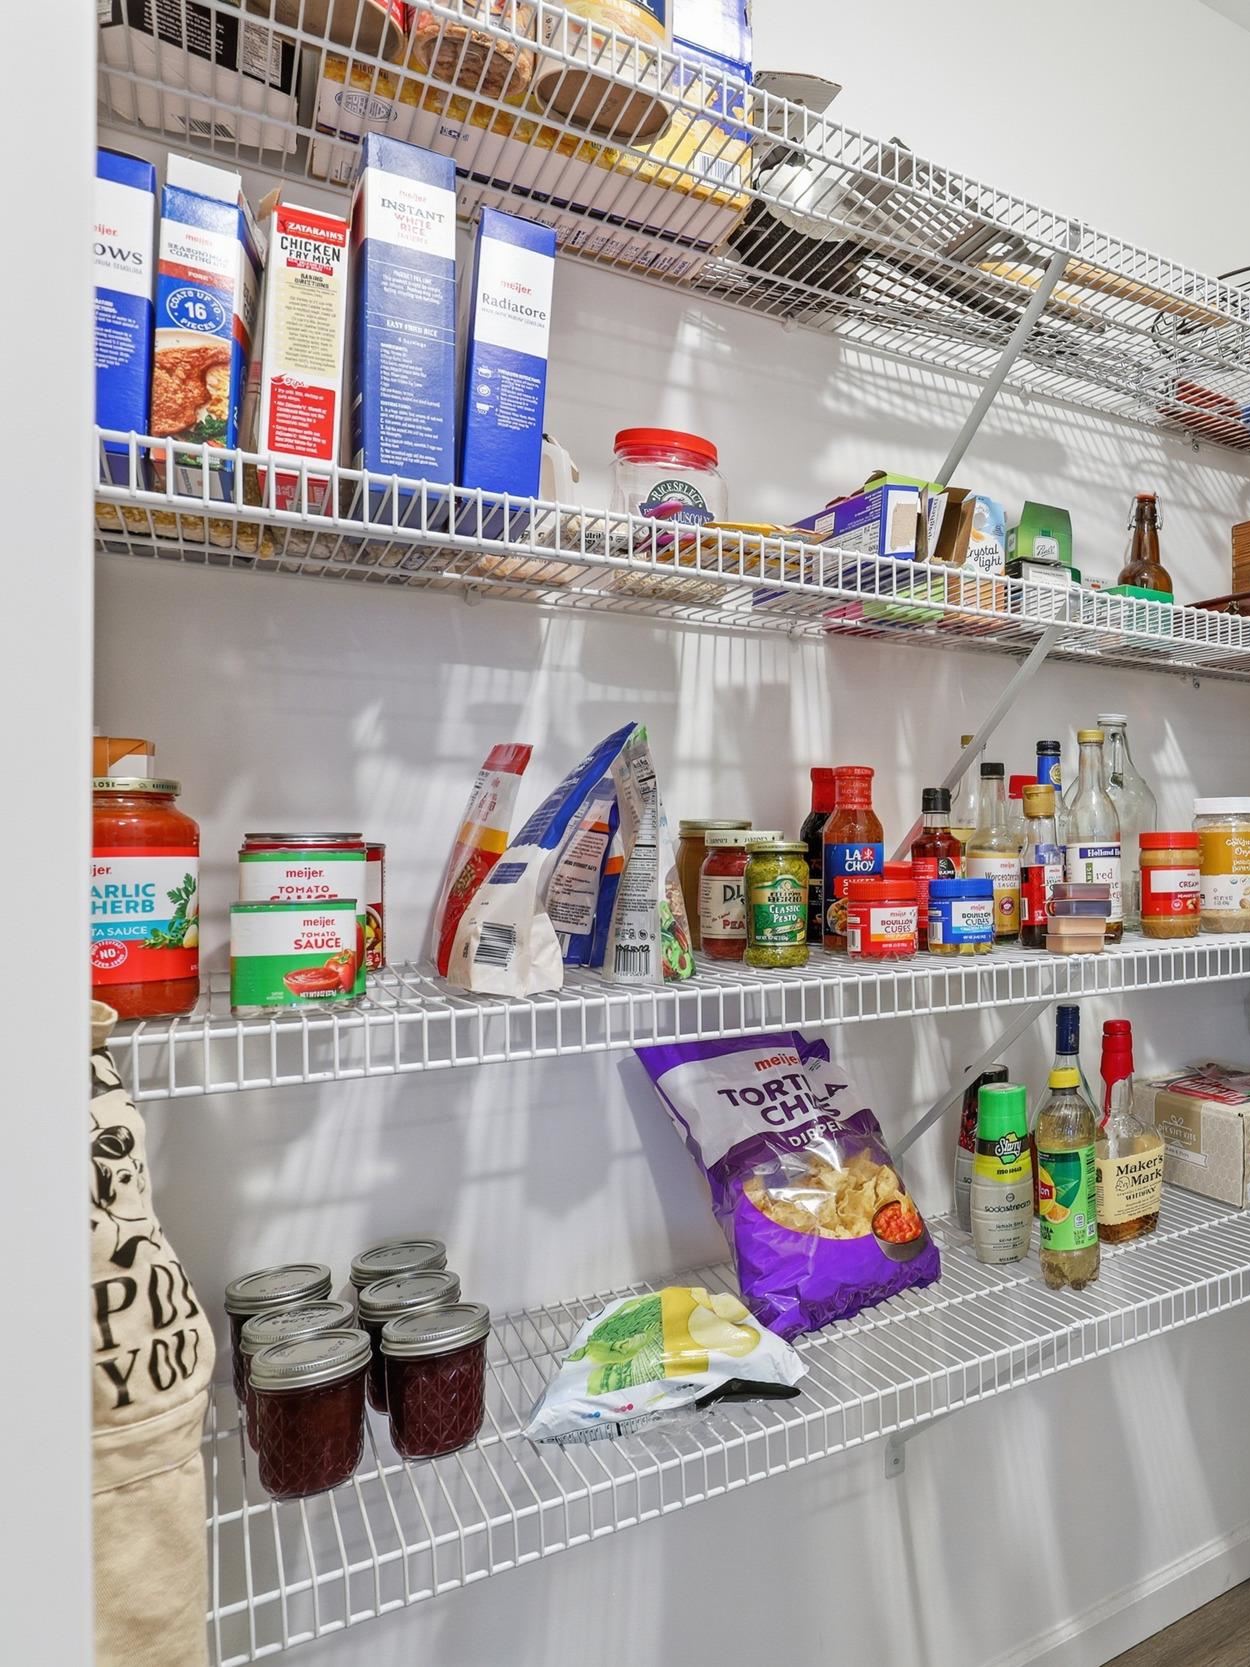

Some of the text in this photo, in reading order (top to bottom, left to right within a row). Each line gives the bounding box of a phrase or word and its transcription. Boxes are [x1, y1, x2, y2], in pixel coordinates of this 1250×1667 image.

[381, 198, 445, 223] INSTANT
[394, 213, 432, 230] WHITE
[94, 224, 118, 237] ijer
[287, 222, 345, 241] ZATARAIN'S
[400, 224, 425, 236] RICE
[281, 236, 341, 262] CHICKEN
[289, 250, 309, 261] FRY
[312, 254, 331, 266] MIX
[501, 279, 532, 296] meijer
[170, 290, 221, 314] COATS UP TO
[482, 292, 546, 320] Radiatore
[184, 302, 207, 320] 16
[180, 317, 216, 331] PIECES
[387, 319, 403, 330] EASY
[424, 326, 438, 337] RICE
[651, 481, 703, 506] RICESELECT
[978, 557, 1003, 572] light
[845, 849, 861, 861] LA
[1087, 849, 1114, 857] Holland
[92, 865, 112, 877] jer
[286, 867, 323, 880] meijer
[845, 860, 875, 872] CHOY
[1096, 868, 1113, 880] red
[91, 883, 156, 899] ARLIC
[278, 885, 329, 894] TOMATO
[1179, 880, 1199, 888] CREAM
[92, 900, 155, 915] HERB
[769, 904, 800, 914] CLASSIC
[303, 917, 335, 928] meijer
[722, 919, 745, 930] PEA
[773, 914, 797, 923] PESTO
[107, 926, 147, 936] SAUCE
[885, 925, 911, 933] CUBES
[294, 938, 341, 950] SAUCE
[100, 948, 115, 959] NO
[754, 1053, 800, 1072] meije
[718, 1074, 848, 1107] TORTILA
[761, 1094, 841, 1126] CHIS
[788, 1120, 848, 1147] DIPPER
[995, 1138, 1021, 1156] Starry
[1116, 1154, 1163, 1177] Maker's
[1130, 1168, 1162, 1187] Mark
[985, 1200, 1031, 1213] sodastream
